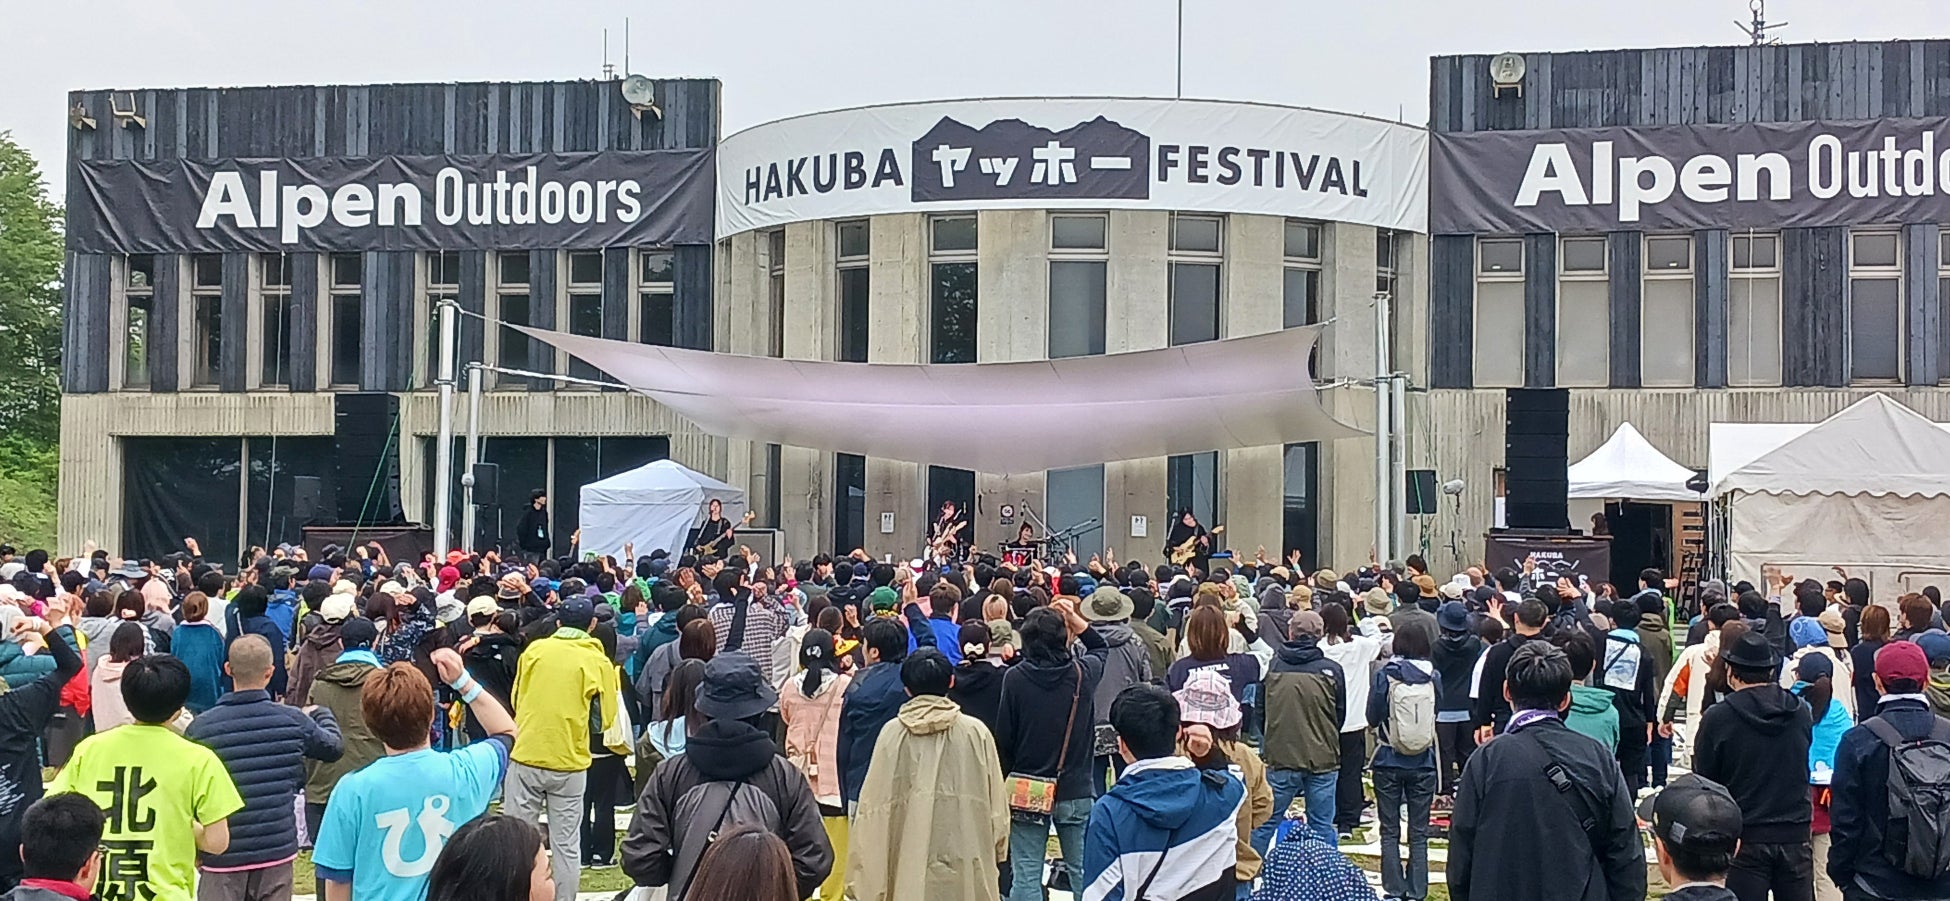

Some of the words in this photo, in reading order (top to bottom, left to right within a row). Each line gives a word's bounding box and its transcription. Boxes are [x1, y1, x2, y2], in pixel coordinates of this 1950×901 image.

[195, 170, 422, 244] Alpen
[435, 165, 641, 226] Outdoors
[744, 148, 904, 206] HAKUBA
[932, 140, 1132, 188] ヤッホー
[1158, 144, 1368, 198] FESTIVAL
[1513, 140, 1791, 222] Alpen
[375, 794, 455, 878] ぴ
